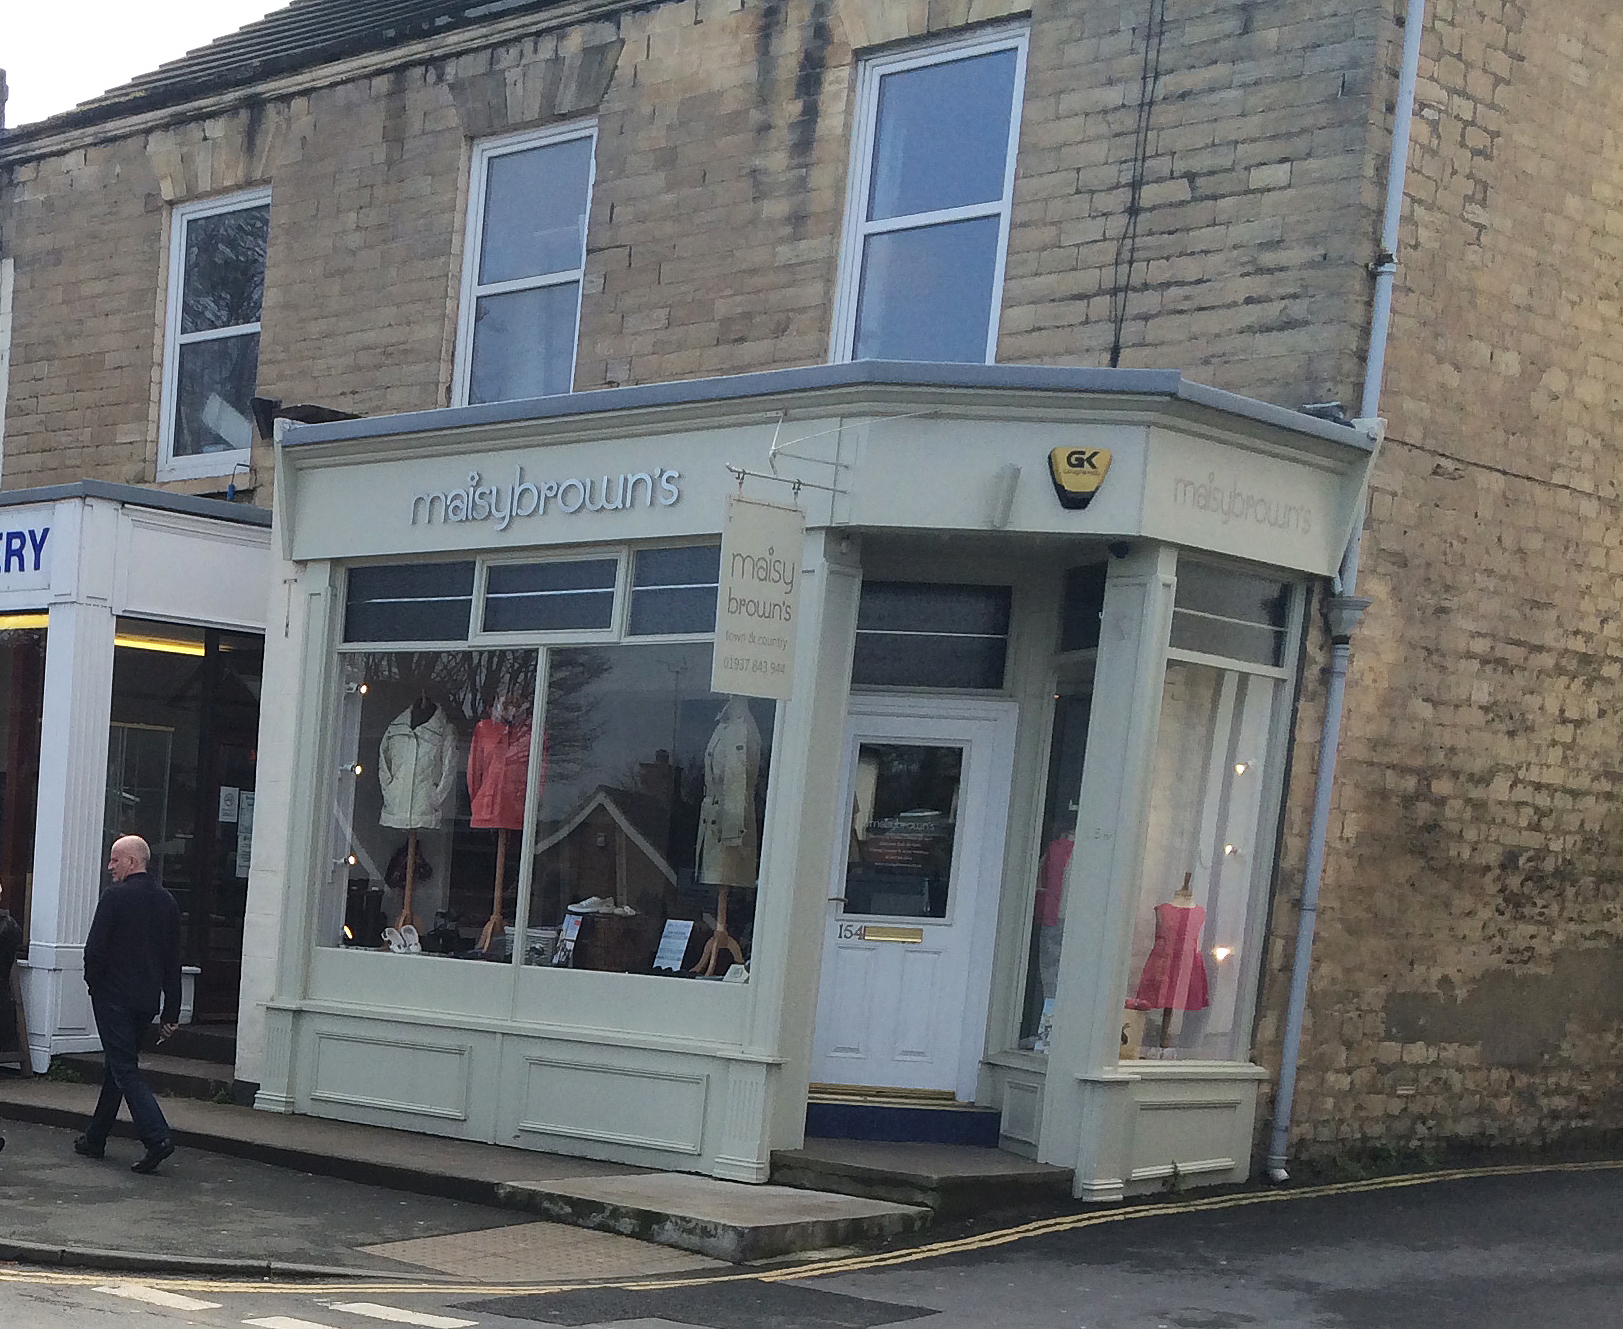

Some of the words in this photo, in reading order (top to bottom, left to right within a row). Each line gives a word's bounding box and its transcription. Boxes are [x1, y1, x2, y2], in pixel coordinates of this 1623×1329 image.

[1067, 450, 1100, 469] GK
[410, 464, 679, 531] maisybrown's
[731, 546, 795, 594] maisy
[727, 587, 792, 621] brown's
[725, 630, 746, 642] town
[756, 635, 788, 650] country
[723, 657, 751, 671] 01937
[752, 659, 768, 674] 843
[838, 923, 864, 940] 154
